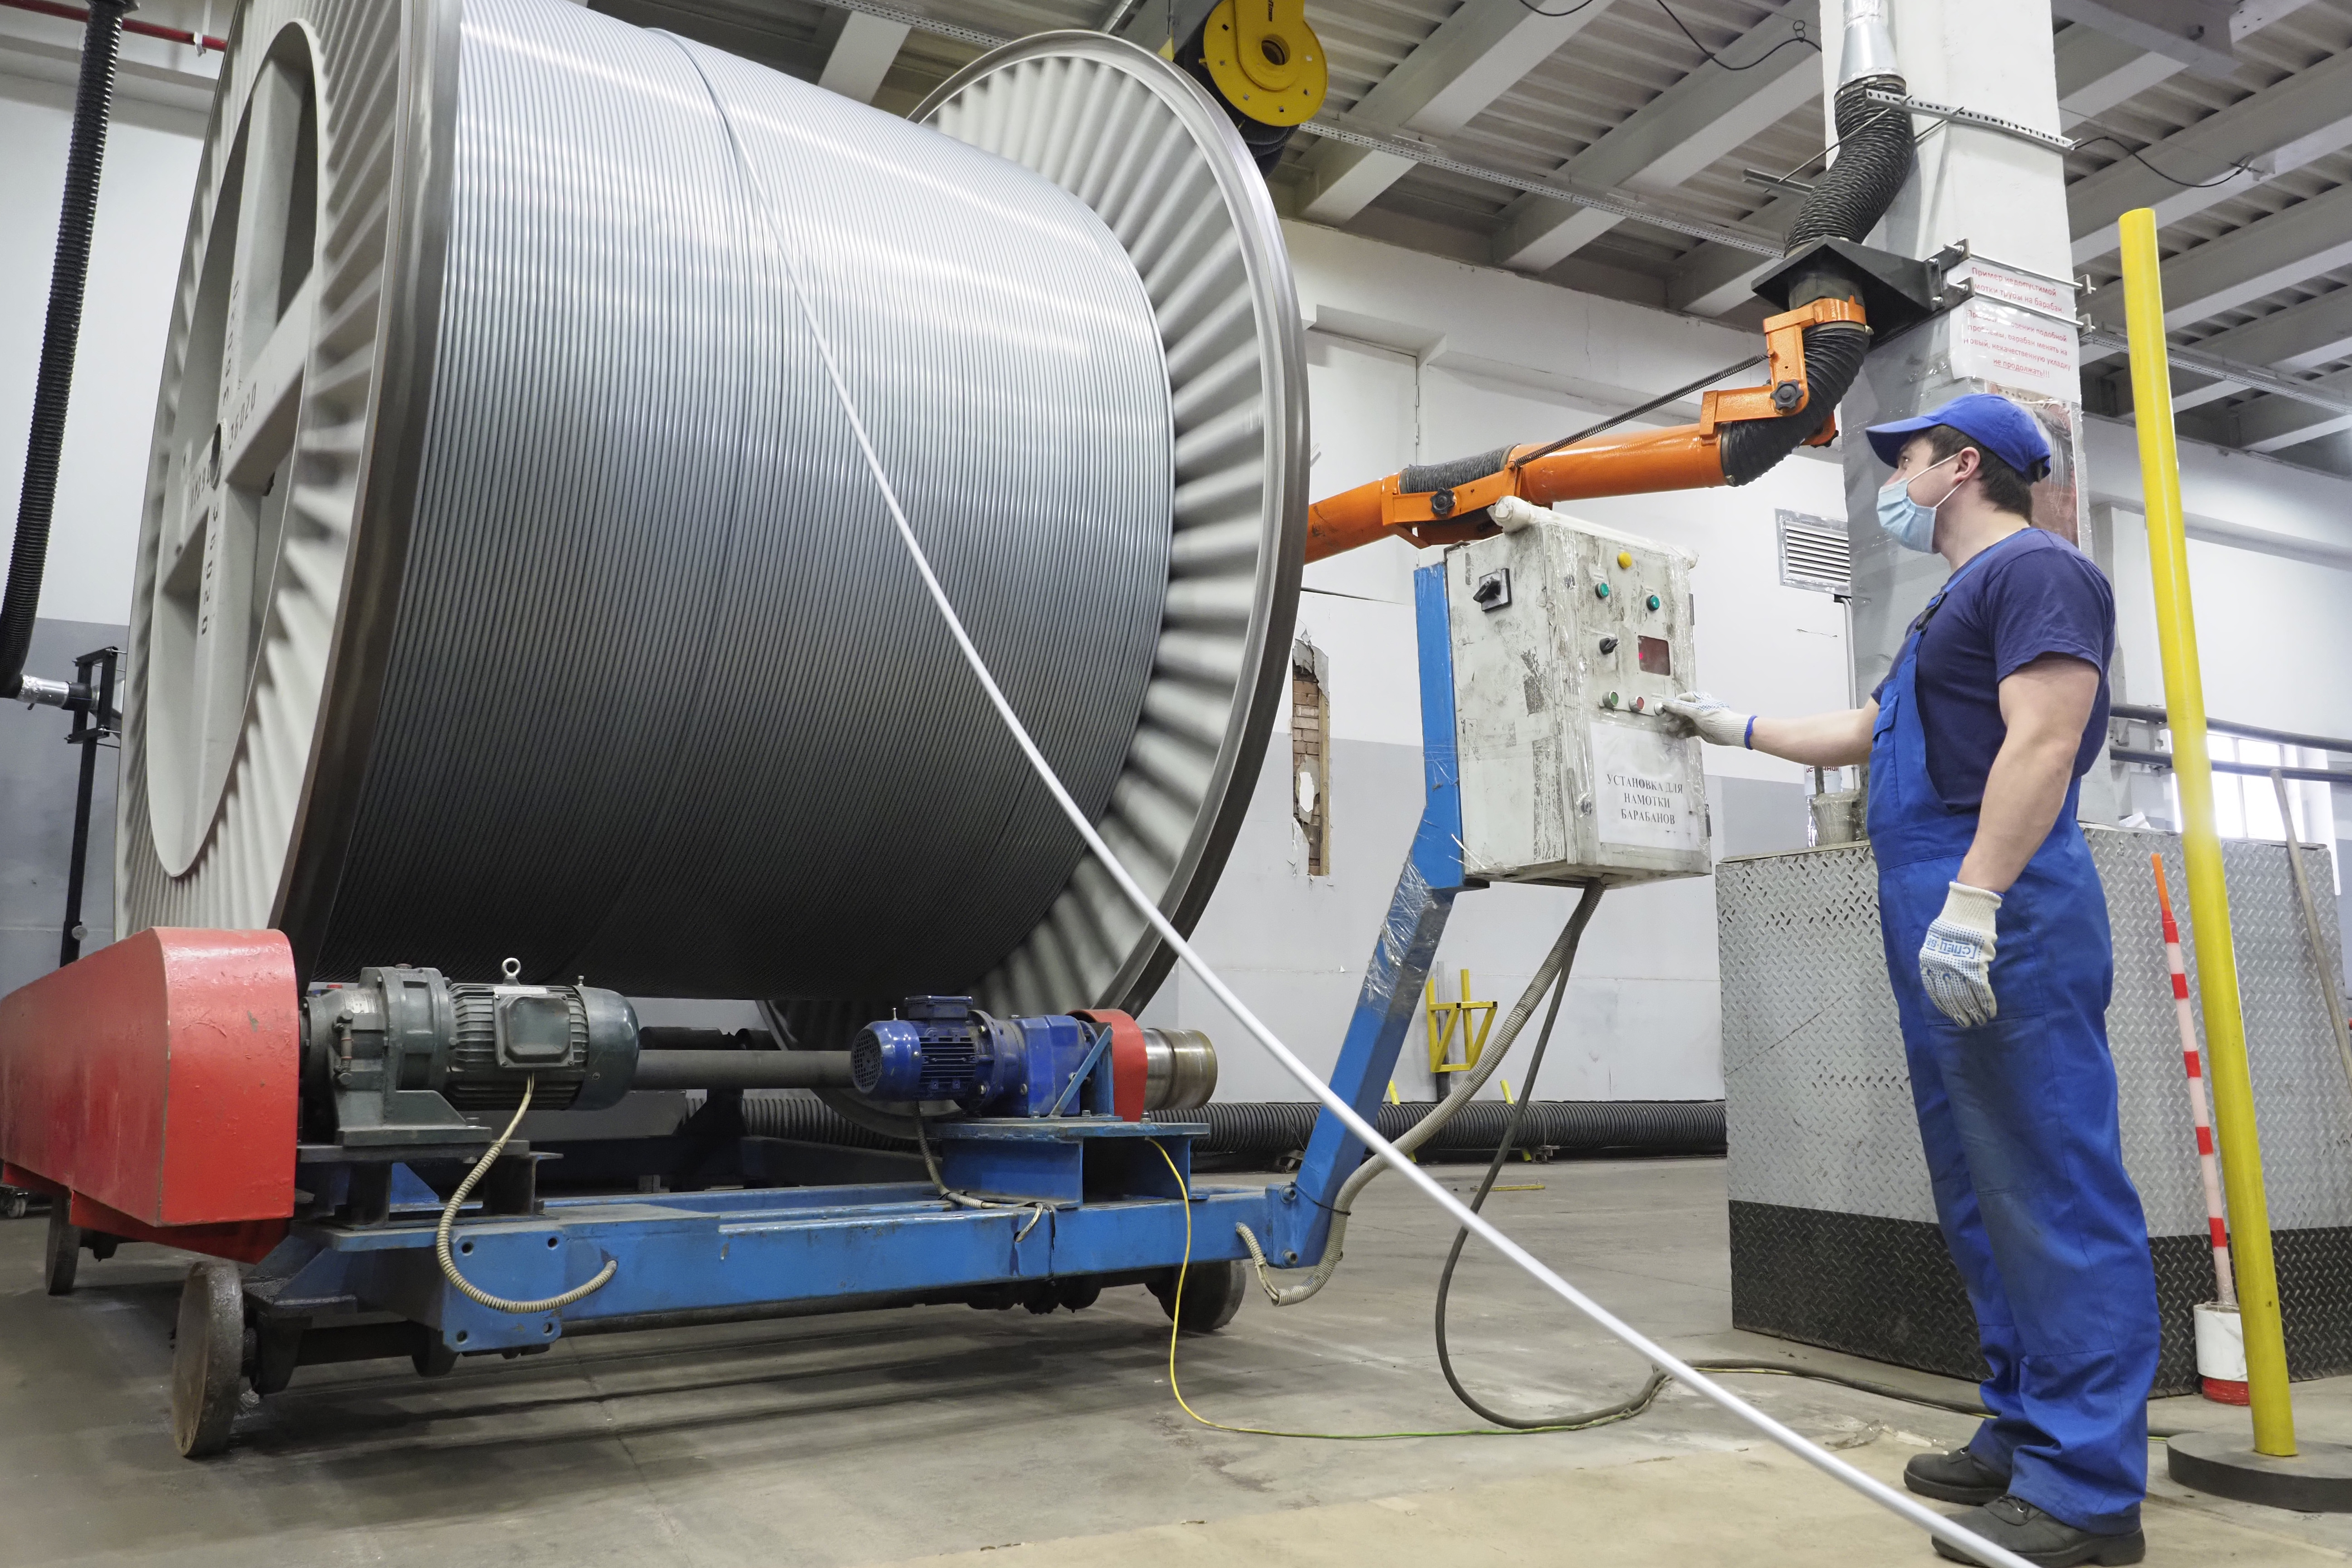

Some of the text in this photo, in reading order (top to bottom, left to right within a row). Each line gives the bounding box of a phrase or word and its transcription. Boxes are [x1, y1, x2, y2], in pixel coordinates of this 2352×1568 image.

[1972, 267, 2056, 297] Пример недопустимой
[1975, 284, 1998, 294] мотки
[2000, 290, 2023, 301] трубы
[2008, 334, 2035, 347] барабан
[2037, 343, 2059, 353] менять
[2036, 329, 2067, 343] подобной
[1992, 343, 2045, 363] некачественную
[2047, 358, 2071, 372] укладку
[2003, 361, 2050, 378] продолжать!!!
[1607, 774, 1683, 794] УСТАНОВКА ДЛЯ
[1624, 793, 1670, 808] НАМОТКИ
[1621, 808, 1675, 824] БАРАБАНОВ
